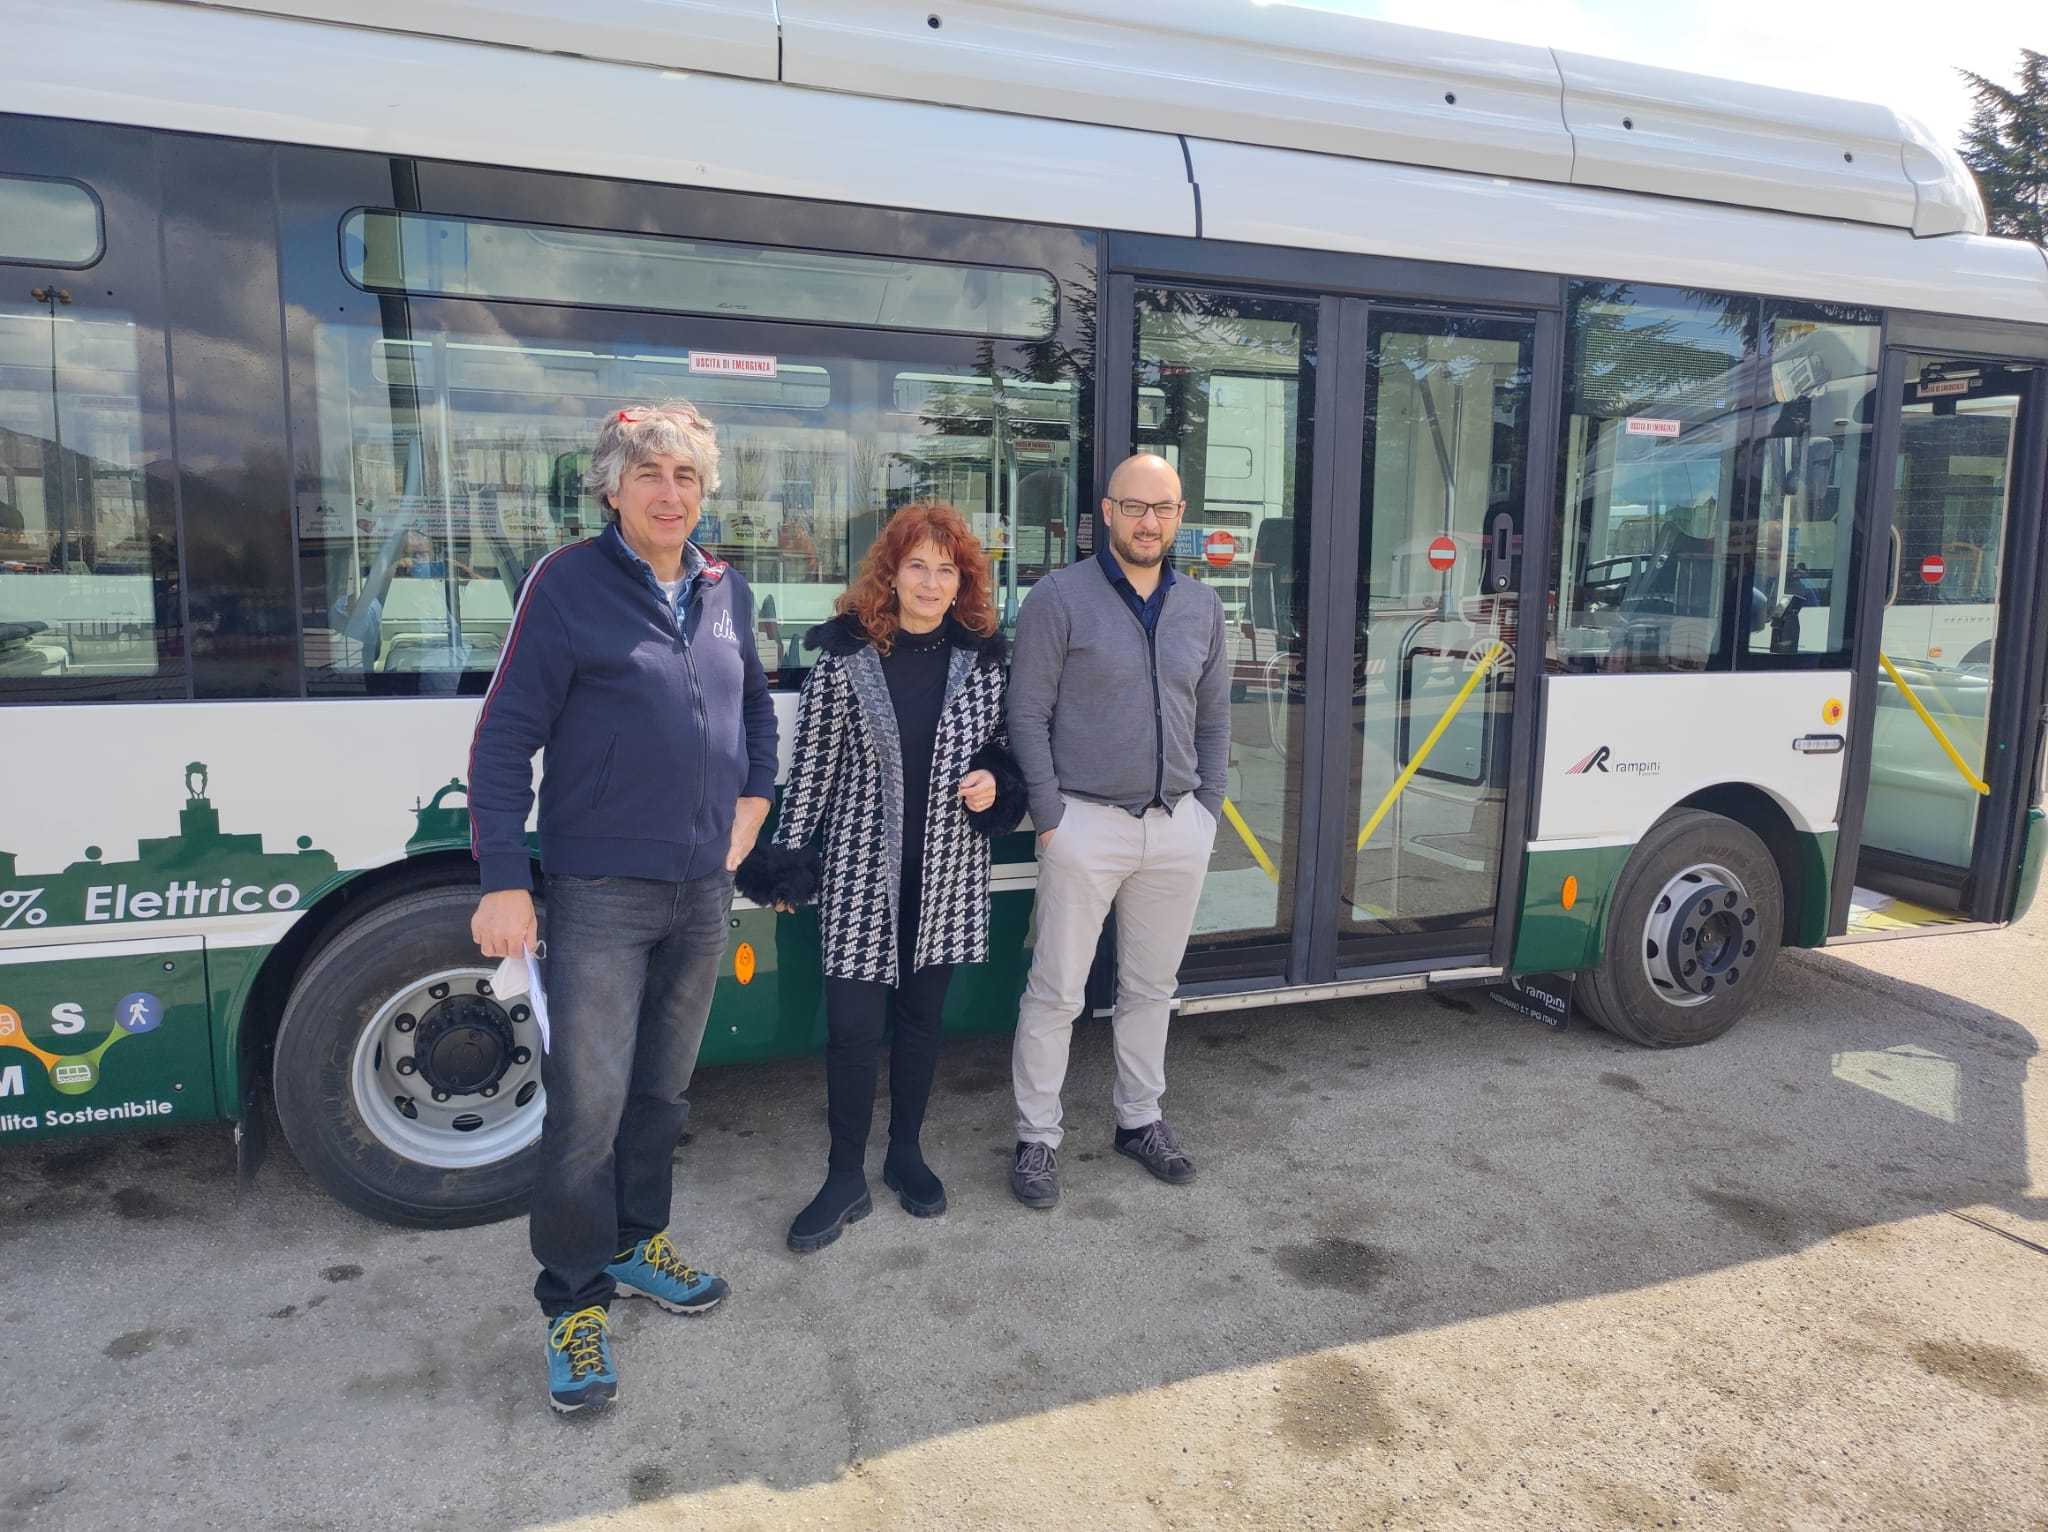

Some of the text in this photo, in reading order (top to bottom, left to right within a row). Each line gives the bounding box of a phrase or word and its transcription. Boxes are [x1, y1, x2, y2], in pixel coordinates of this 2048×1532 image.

[695, 357, 770, 371] USCITA DI EMERGENZA
[1615, 760, 1661, 776] rampini
[84, 878, 300, 921] Elettrico
[1526, 985, 1565, 1010] rampini
[51, 1002, 86, 1035] S
[0, 1100, 173, 1132] lita Sostenibile
